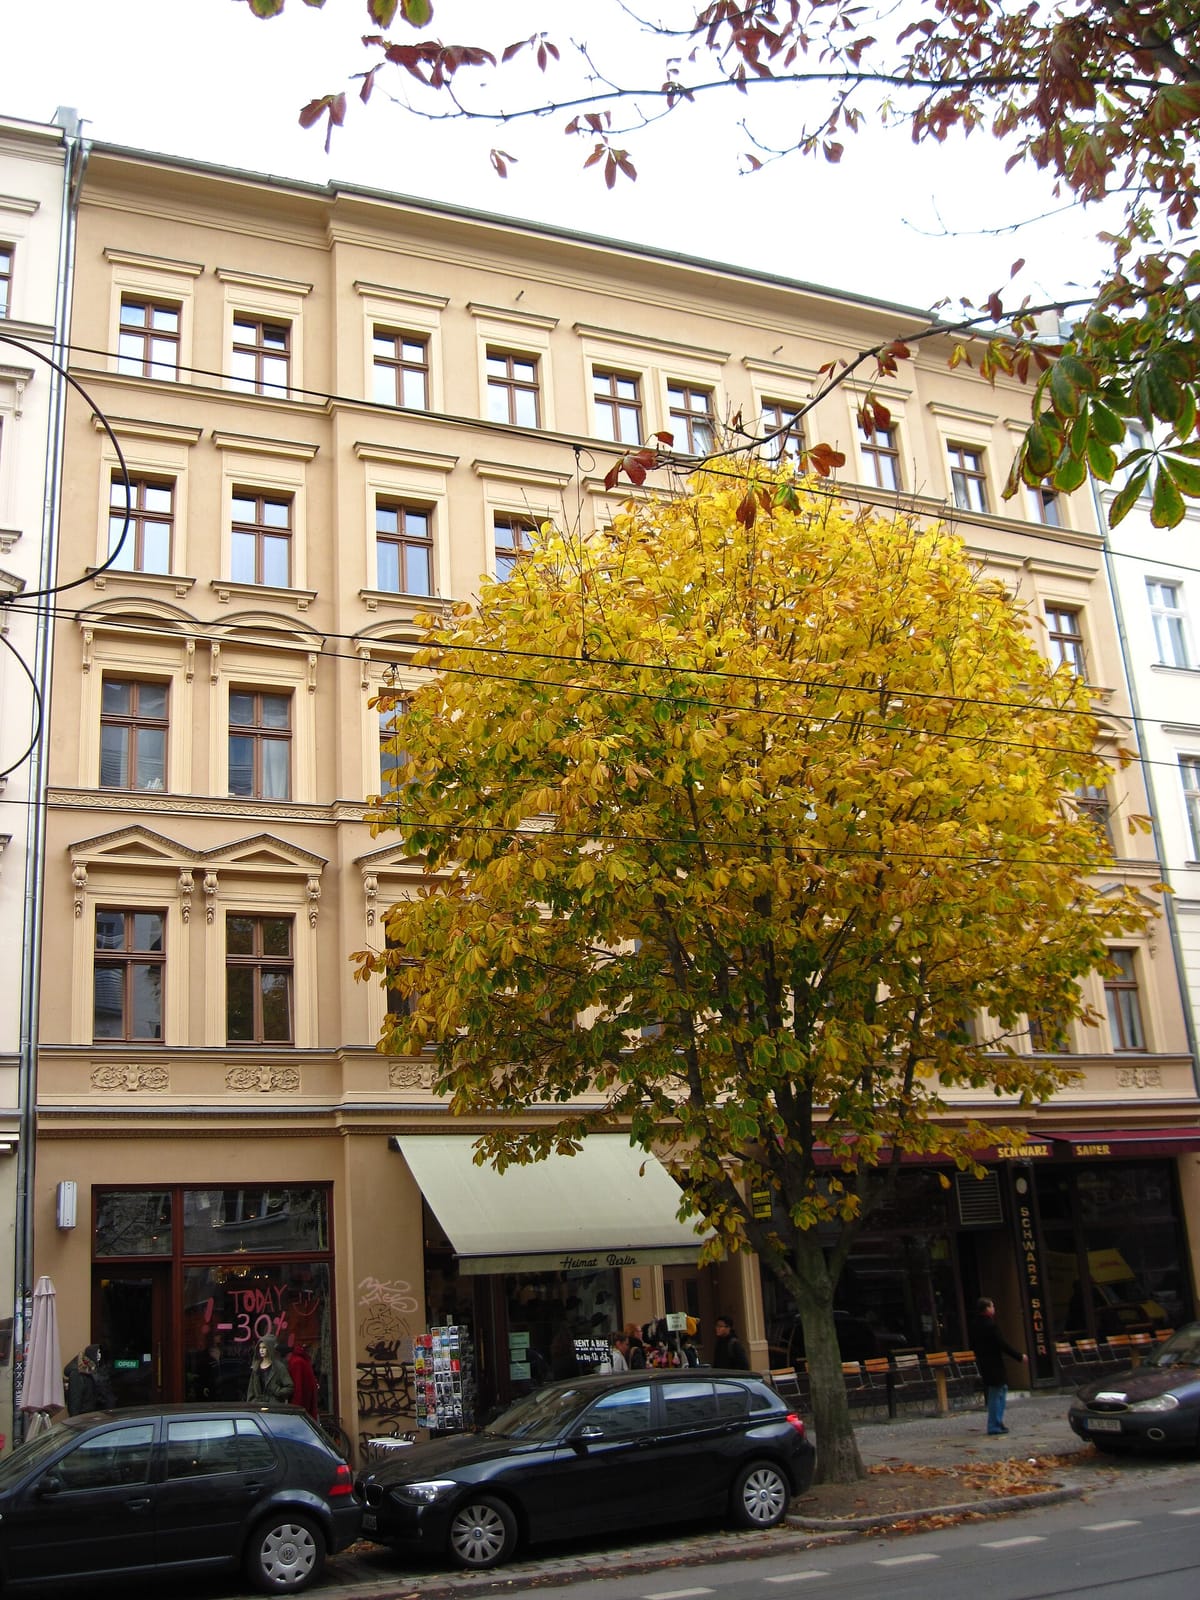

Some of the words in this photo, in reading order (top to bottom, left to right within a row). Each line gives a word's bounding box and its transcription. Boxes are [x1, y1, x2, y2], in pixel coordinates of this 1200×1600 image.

[998, 1145, 1048, 1158] SCHWARZ
[1076, 1144, 1111, 1156] SAUER
[560, 1257, 598, 1269] Heimat
[606, 1254, 637, 1266] Berlin
[1019, 1206, 1037, 1285] SCHWARZ
[1031, 1299, 1047, 1355] SAUER
[227, 1284, 288, 1313] TODAY
[573, 1339, 590, 1347] RENT
[595, 1339, 609, 1347] BIKE
